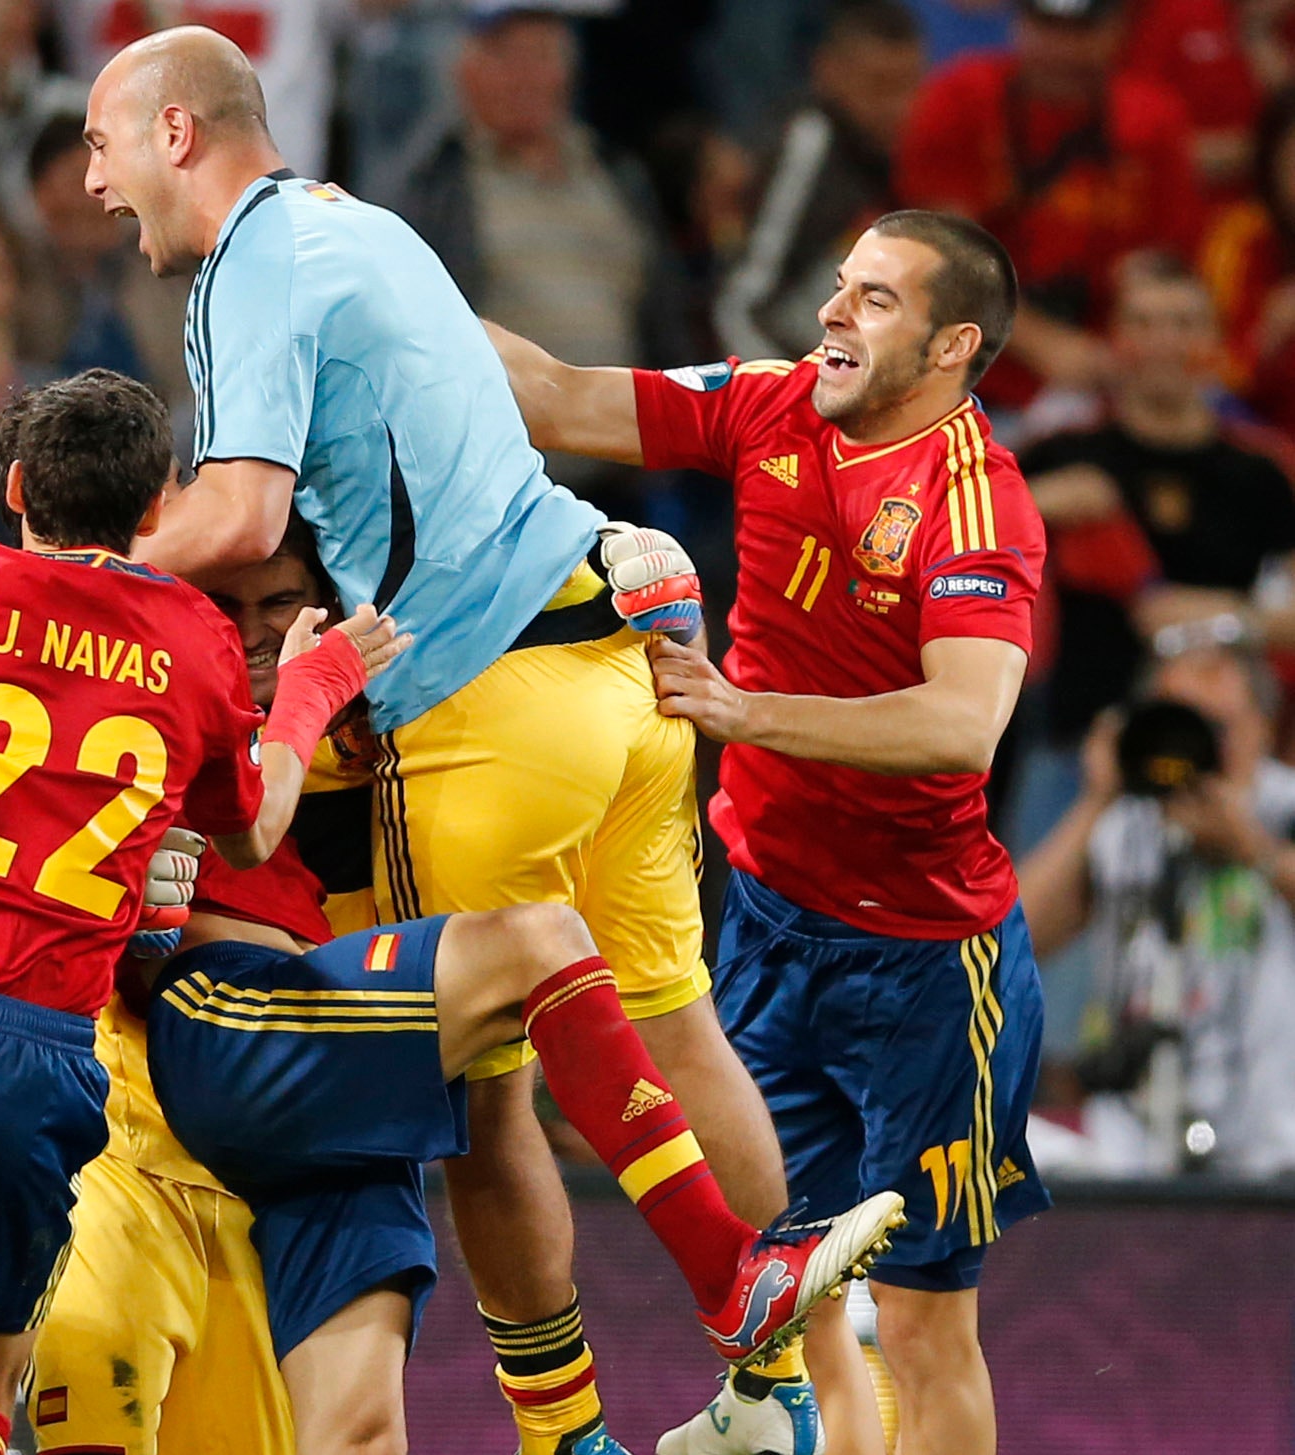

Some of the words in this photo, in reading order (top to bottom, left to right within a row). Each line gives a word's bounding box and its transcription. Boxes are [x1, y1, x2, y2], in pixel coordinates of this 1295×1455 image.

[759, 459, 799, 489] adidas
[784, 536, 832, 612] 11
[947, 578, 1004, 596] RESPECT
[41, 619, 172, 695] NAVAS
[621, 1092, 674, 1122] adidas
[919, 1138, 969, 1231] 11
